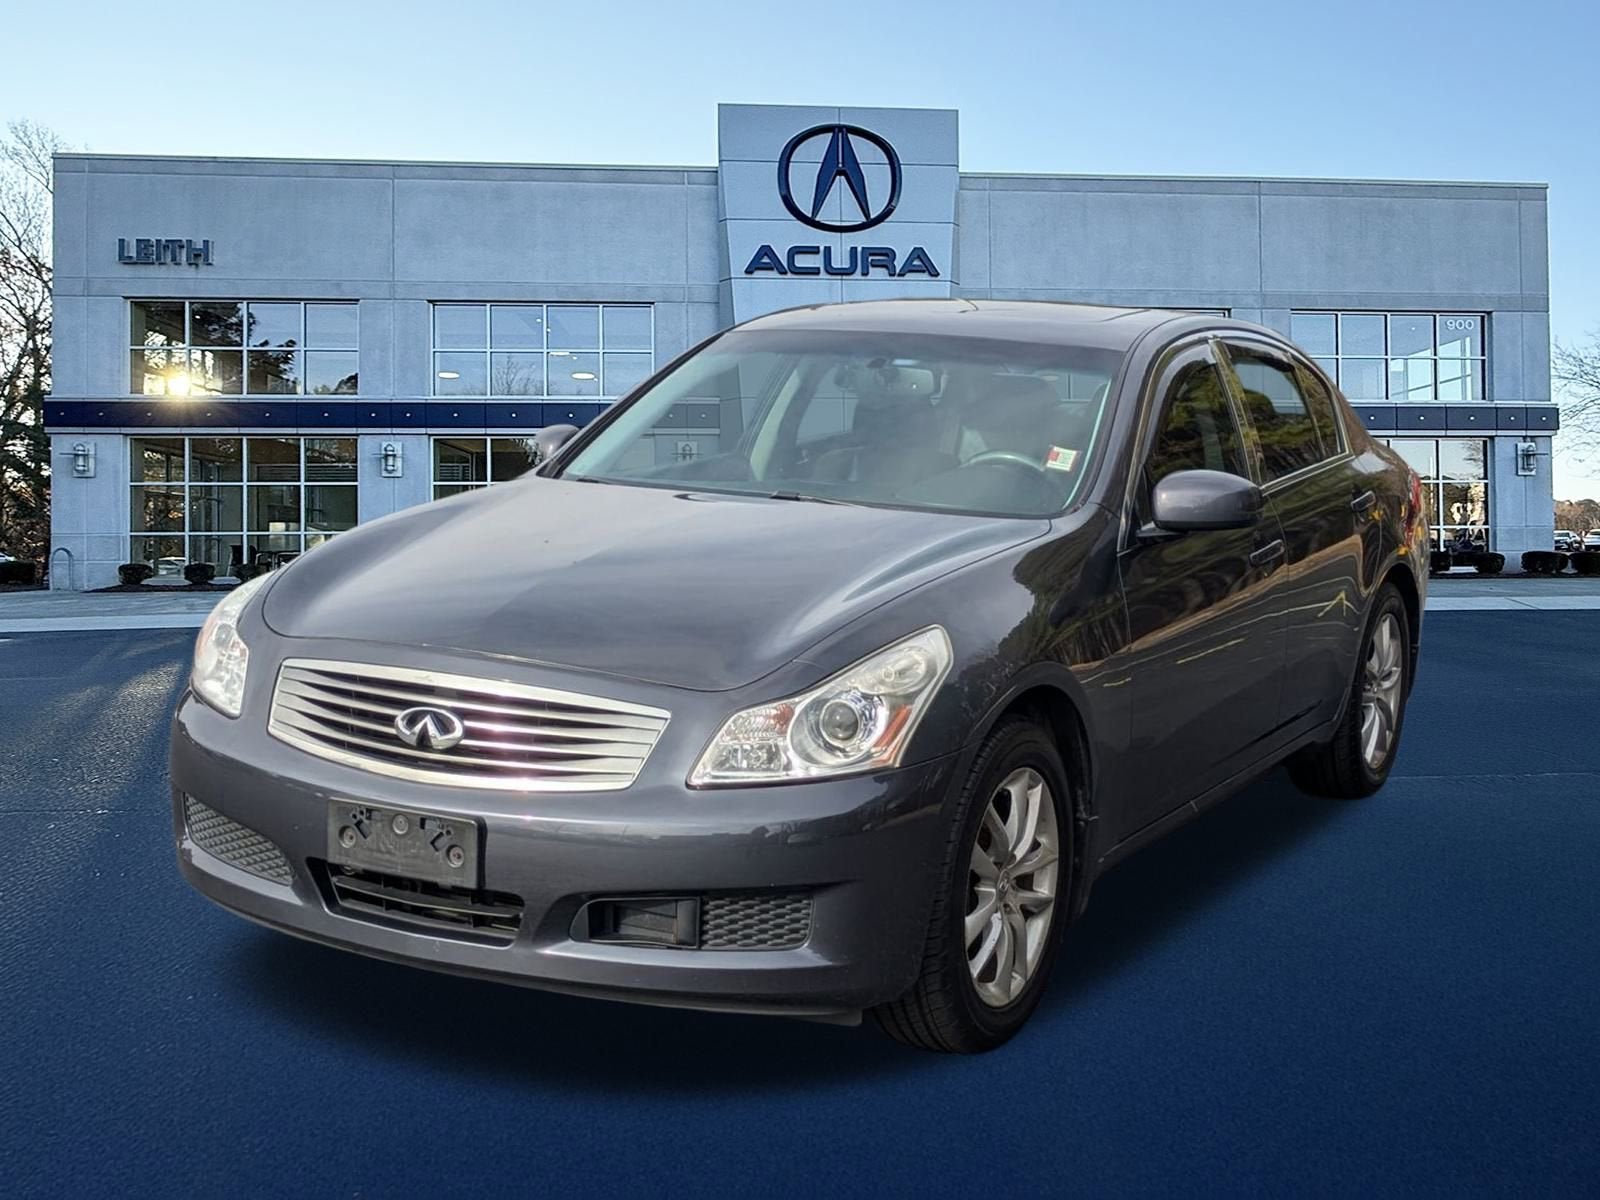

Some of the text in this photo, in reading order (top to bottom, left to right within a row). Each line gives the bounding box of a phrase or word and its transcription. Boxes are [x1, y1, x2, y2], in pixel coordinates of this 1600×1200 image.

[118, 238, 213, 265] LEITH
[744, 245, 940, 277] ACURA
[1446, 319, 1474, 330] 900
